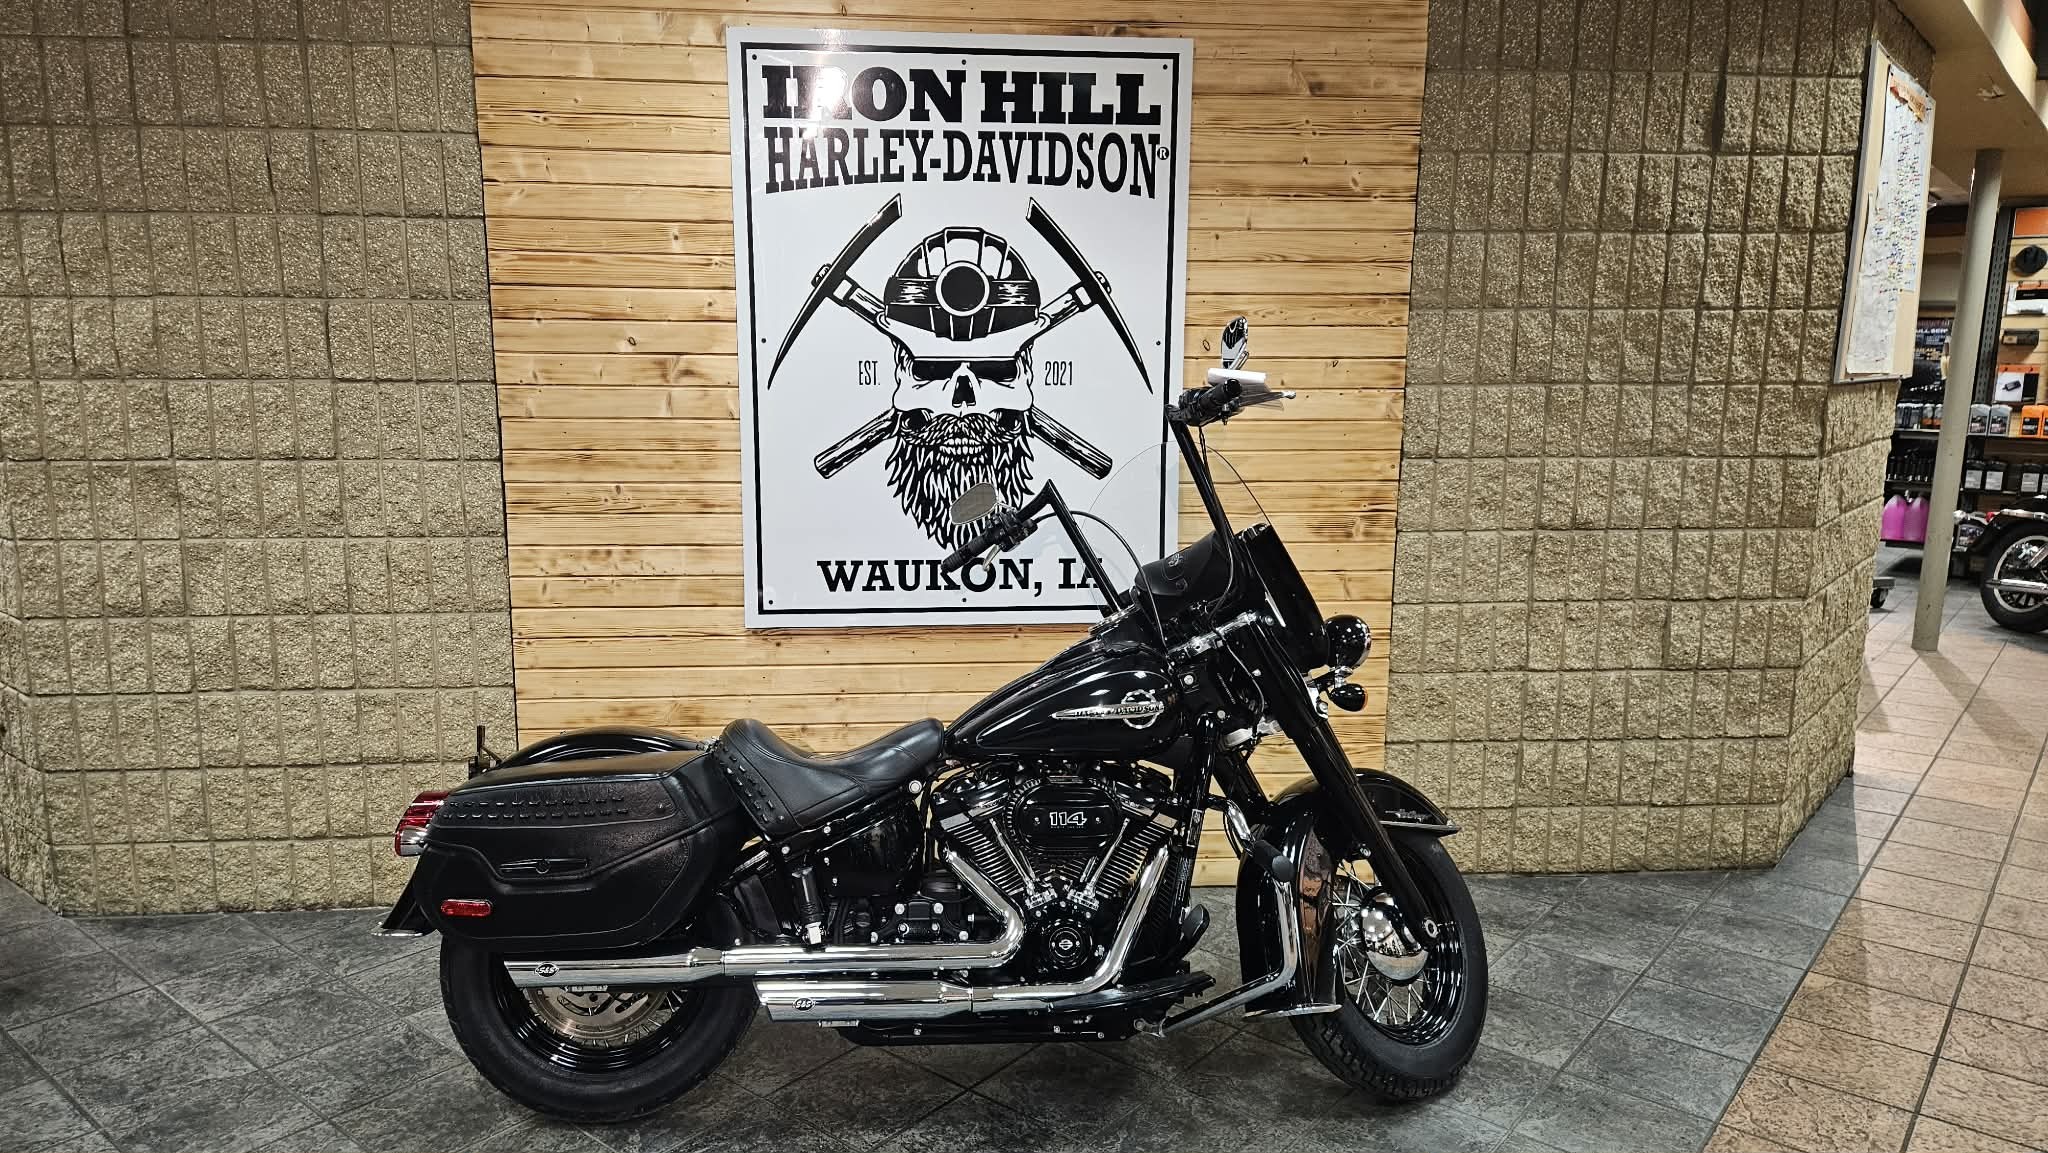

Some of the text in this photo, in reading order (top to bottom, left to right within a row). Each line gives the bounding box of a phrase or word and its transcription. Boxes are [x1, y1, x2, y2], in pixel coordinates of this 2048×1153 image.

[761, 64, 1162, 126] IRON HILL
[858, 360, 881, 386] EST.
[1044, 360, 1073, 386] 2021
[1049, 811, 1088, 826] 114
